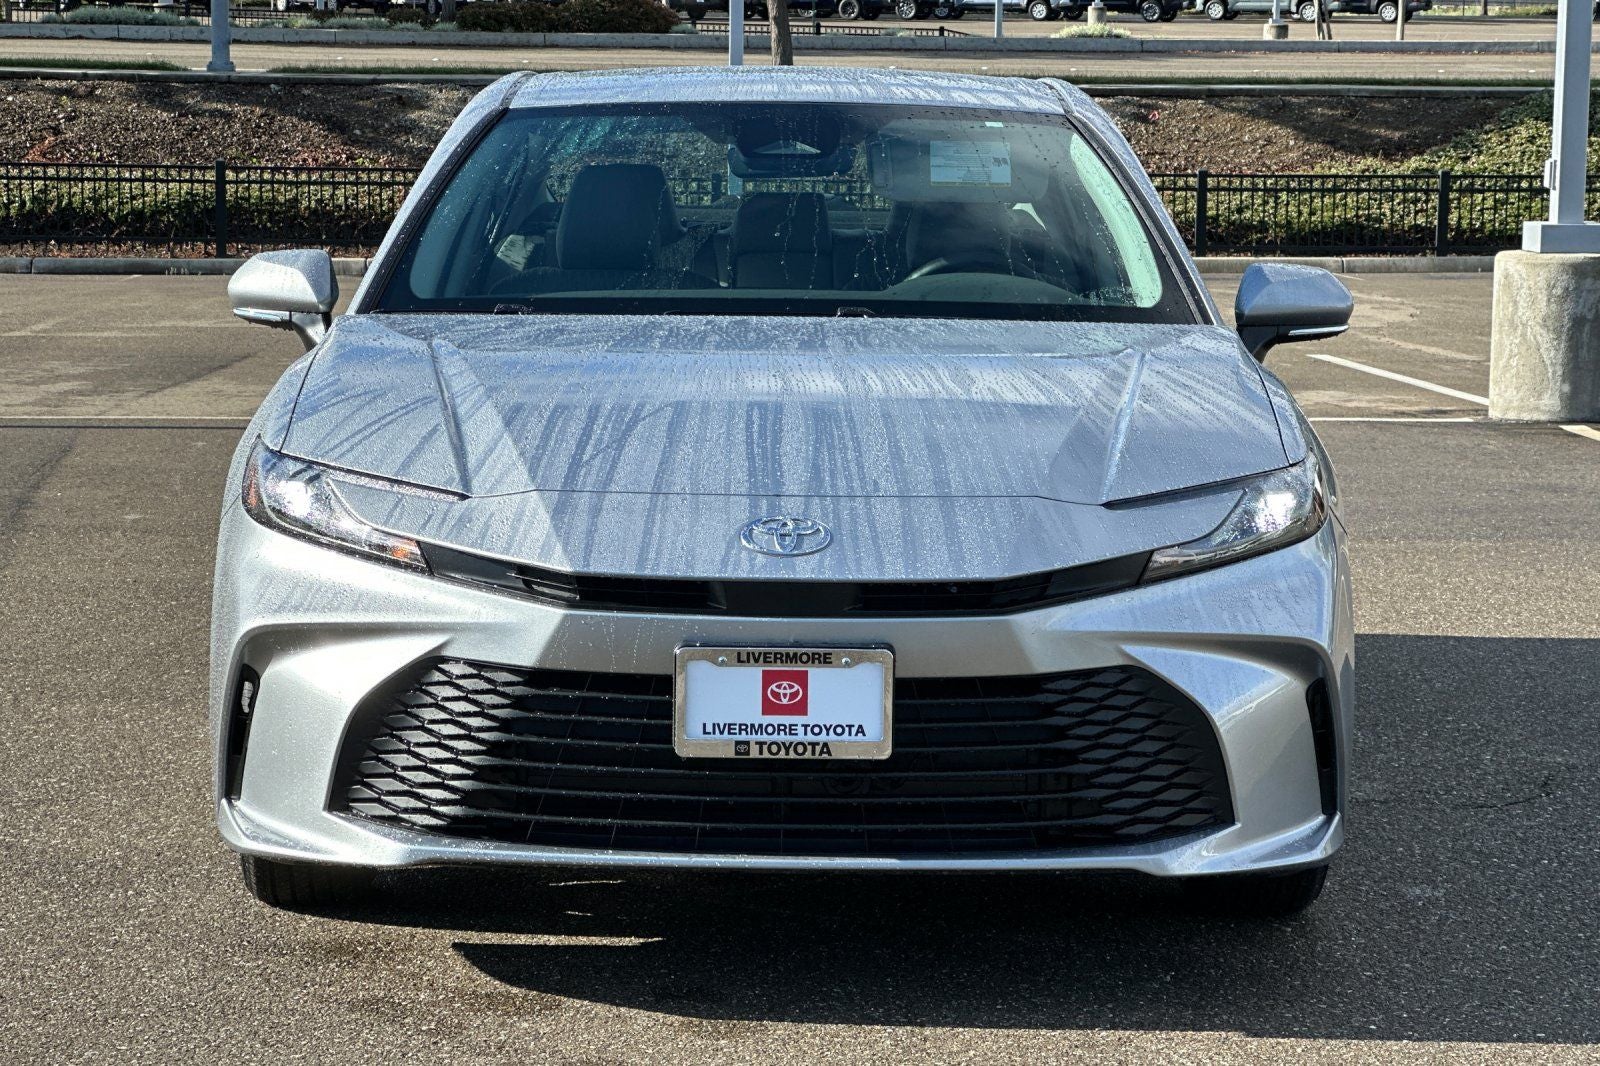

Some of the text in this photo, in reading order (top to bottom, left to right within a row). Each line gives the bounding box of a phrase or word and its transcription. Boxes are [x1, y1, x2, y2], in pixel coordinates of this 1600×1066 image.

[737, 651, 833, 665] LIVERMORE
[702, 722, 867, 737] LIVERMORE TOYOTA
[755, 741, 833, 757] TOYOTA
